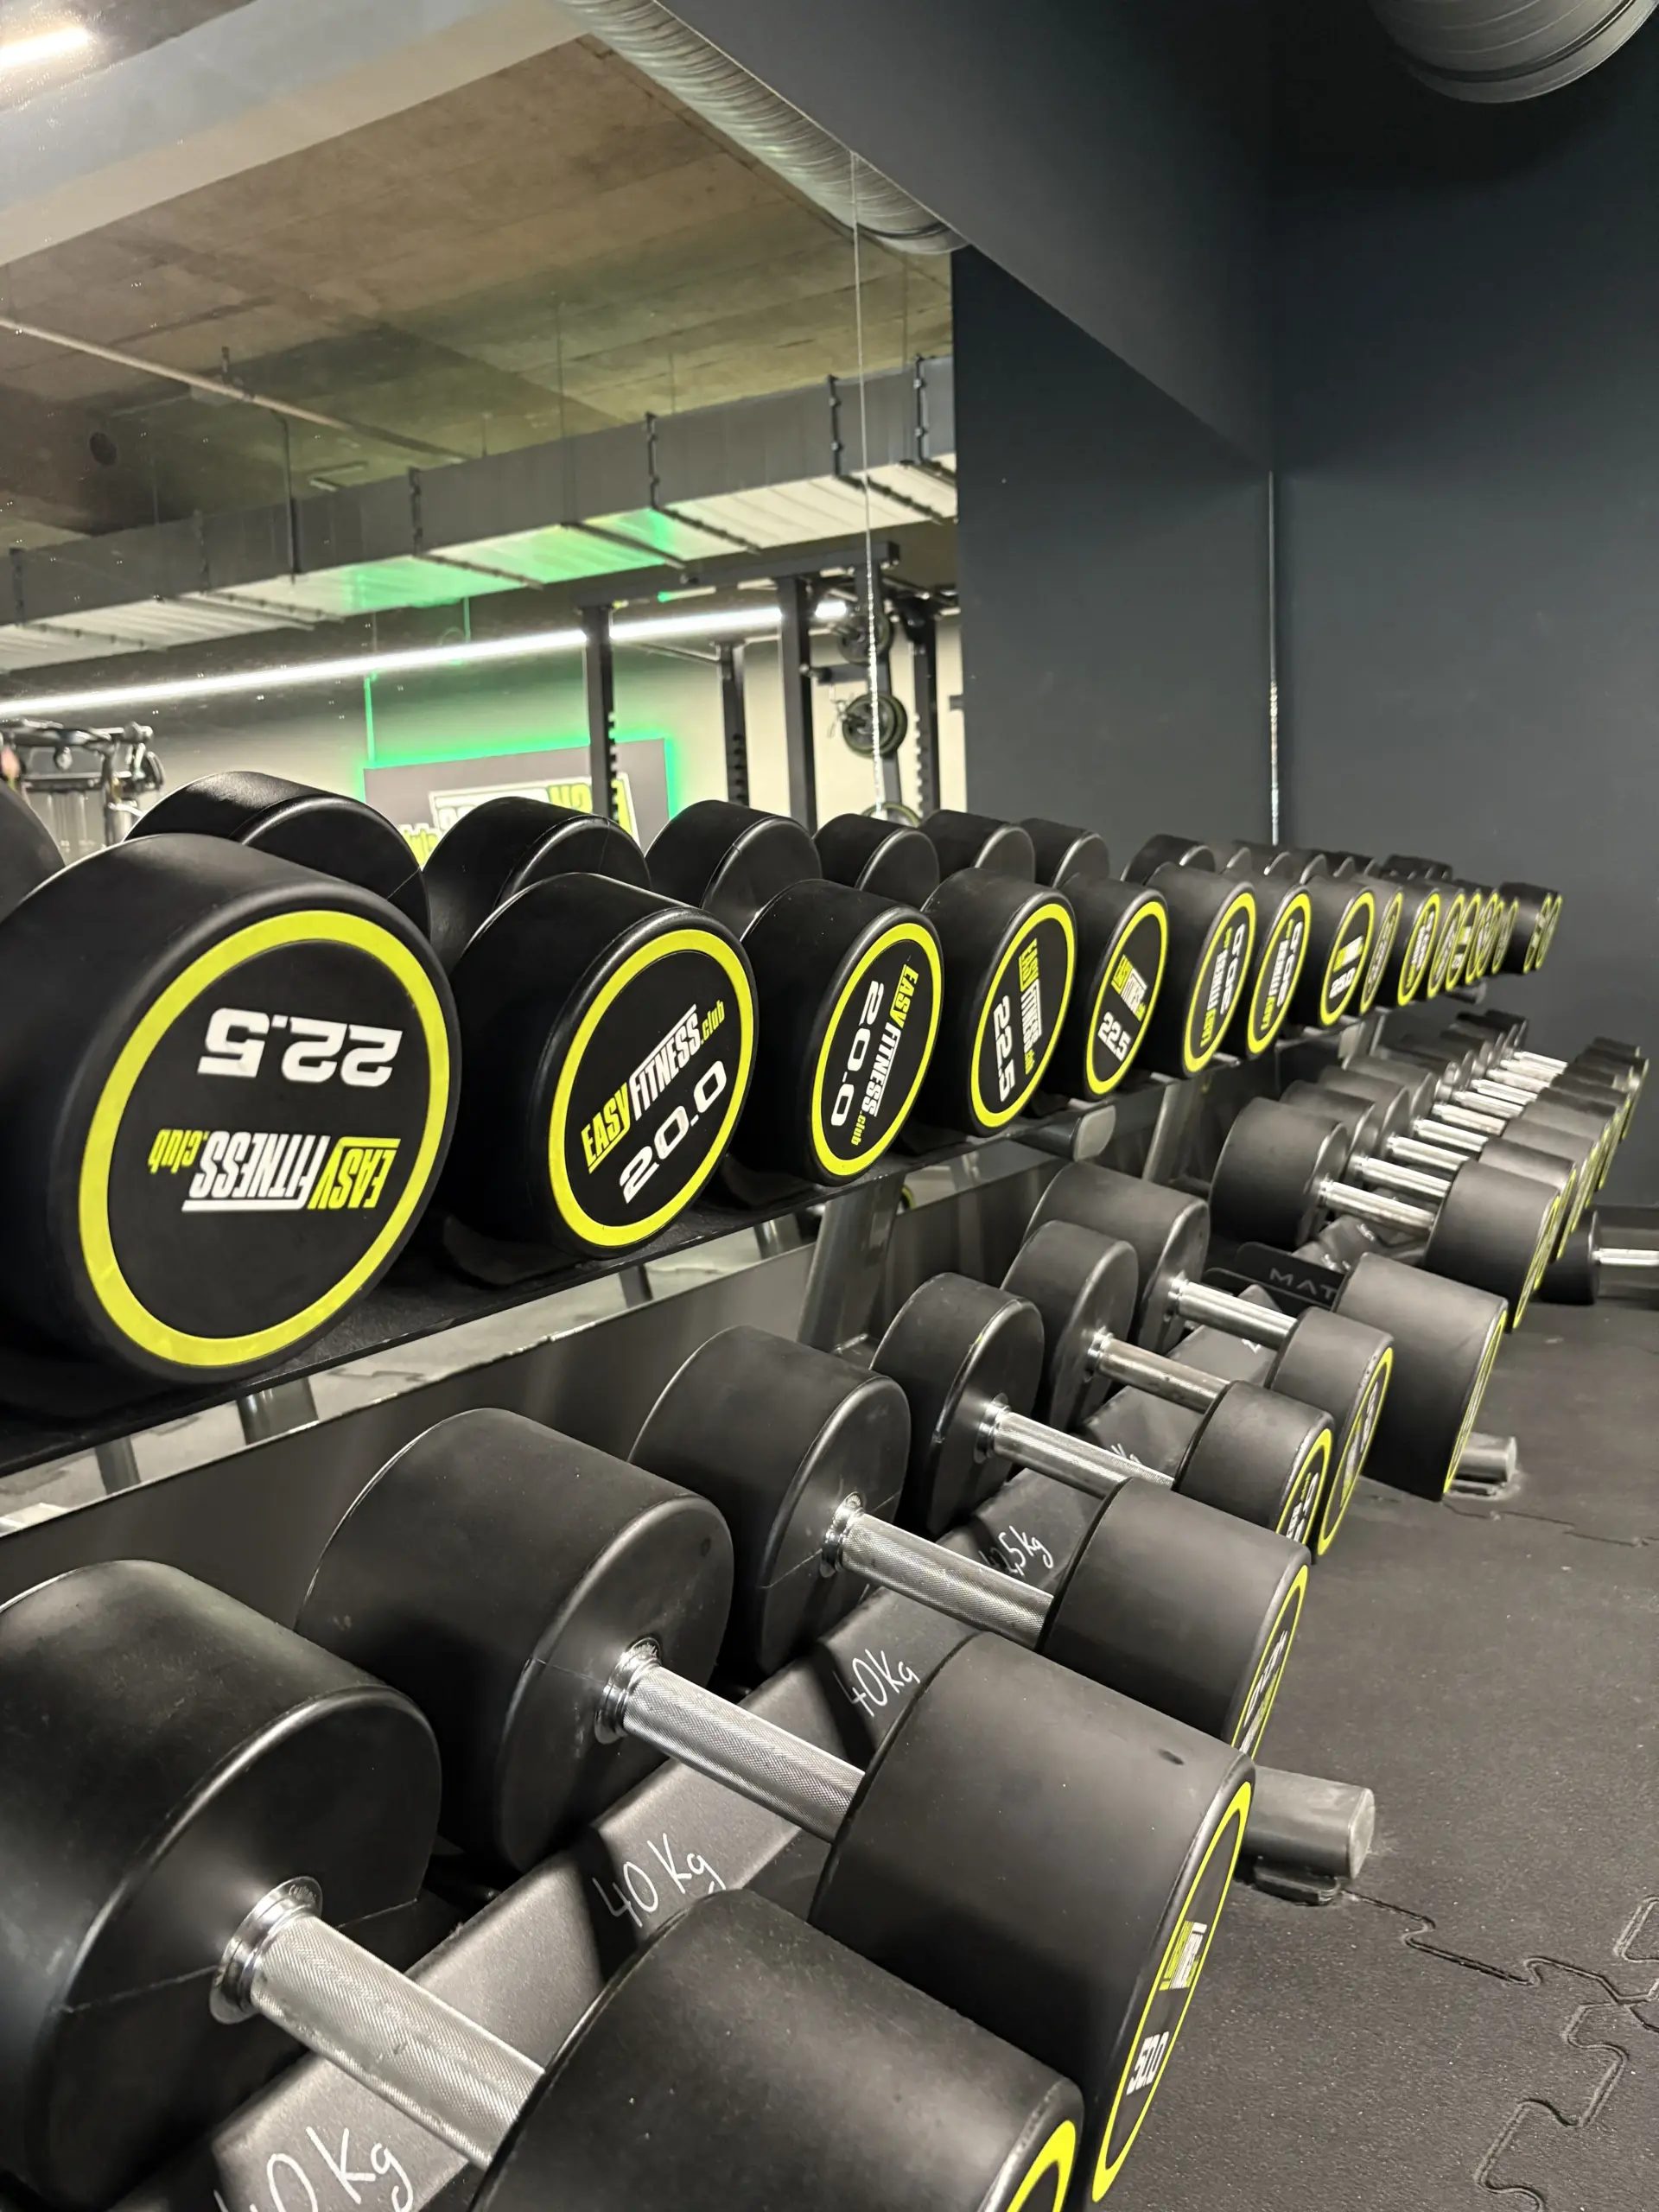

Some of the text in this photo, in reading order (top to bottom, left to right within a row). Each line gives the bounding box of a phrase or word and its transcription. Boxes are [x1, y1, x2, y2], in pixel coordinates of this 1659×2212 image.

[196, 1007, 404, 1089] 22.5
[830, 980, 886, 1127] 20.0
[993, 995, 1016, 1103] 22.5
[619, 1060, 728, 1205] 20.0
